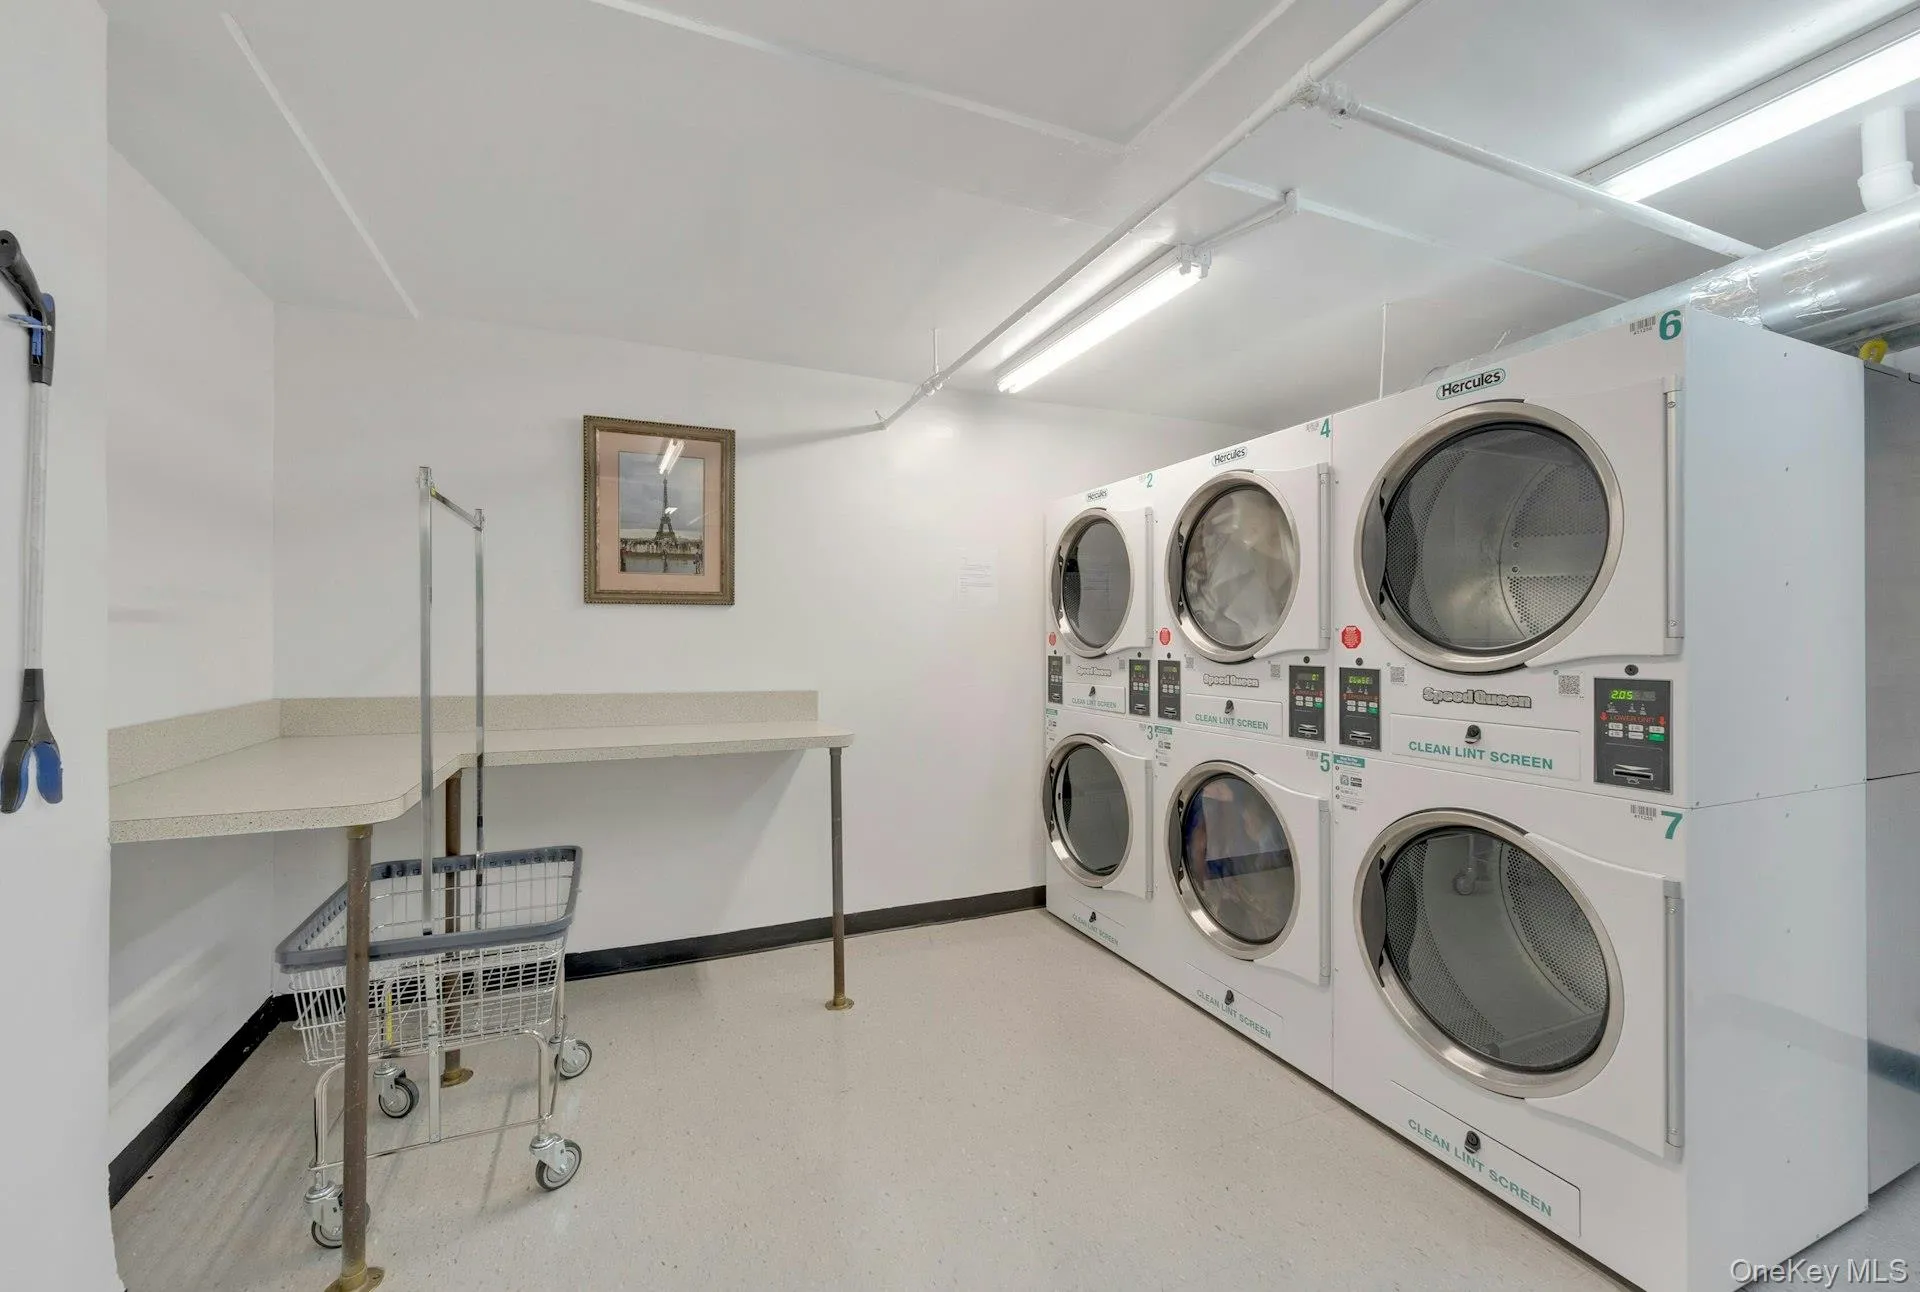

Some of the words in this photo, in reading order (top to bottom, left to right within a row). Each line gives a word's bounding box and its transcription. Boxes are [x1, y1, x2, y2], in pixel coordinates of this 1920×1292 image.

[1659, 310, 1681, 341] 6
[1442, 371, 1501, 397] Hercules
[1320, 418, 1331, 438] 4
[1214, 448, 1246, 465] Hercules
[1146, 473, 1153, 488] 2
[1611, 690, 1633, 700] 2.05
[1195, 713, 1218, 722] CLEAN
[1219, 716, 1236, 725] LINT
[1237, 718, 1269, 731] SCREEN
[1147, 725, 1153, 740] 3
[1320, 752, 1330, 772] 5
[1408, 741, 1451, 756] CLEAN
[1455, 747, 1485, 760] LINT
[1490, 752, 1553, 770] SCREEN
[1661, 810, 1682, 840] 7
[1196, 989, 1220, 1008] CLEAN
[1221, 1005, 1237, 1018] LINT
[1239, 1013, 1272, 1039] SCREEN
[1408, 1118, 1450, 1152] CLEAN
[1454, 1146, 1485, 1172] LINT
[1488, 1169, 1552, 1217] SCREEN
